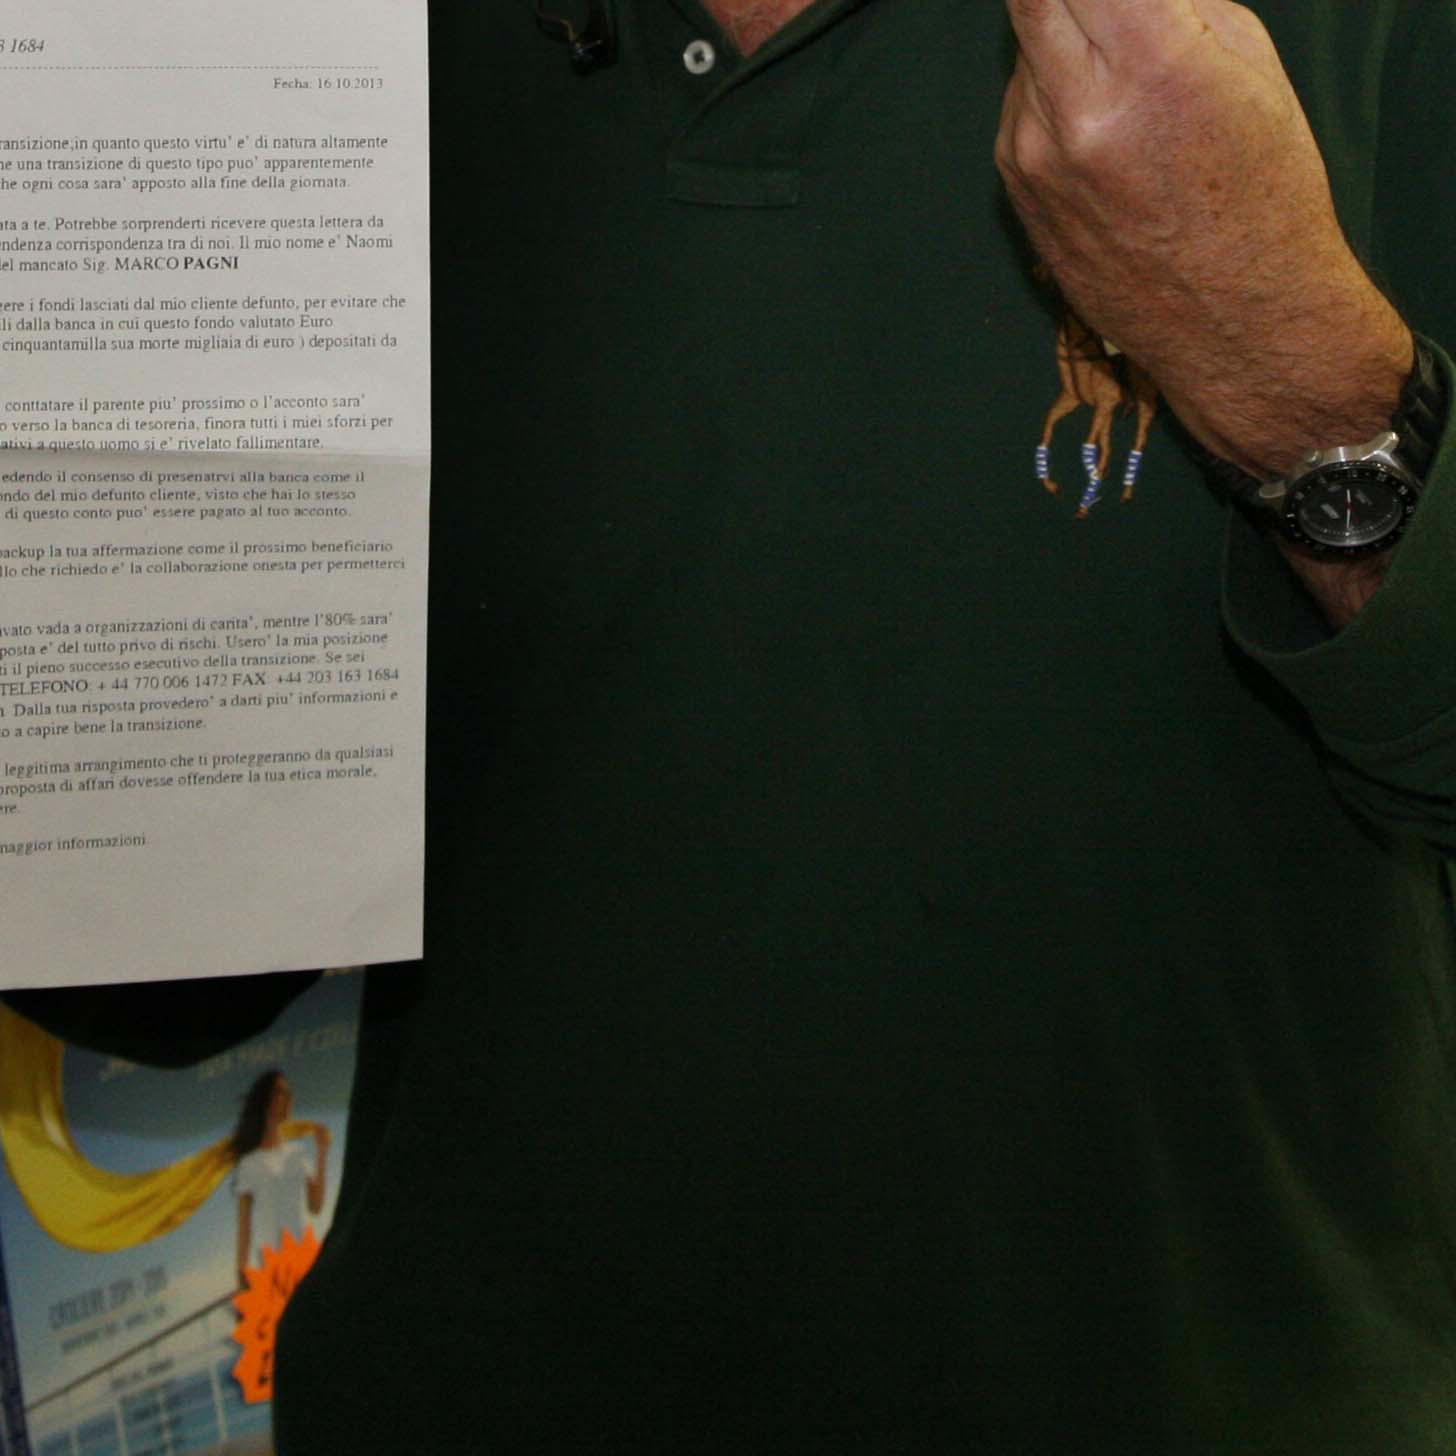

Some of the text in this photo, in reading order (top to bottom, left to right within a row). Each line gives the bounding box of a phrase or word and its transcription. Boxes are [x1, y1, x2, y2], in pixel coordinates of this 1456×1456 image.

[9, 37, 44, 54] 1684
[91, 136, 140, 154] quanto
[142, 136, 190, 153] questo
[254, 133, 268, 149] di
[272, 136, 316, 150] natura
[320, 133, 388, 149] altamente
[18, 259, 78, 272] mancato
[82, 255, 109, 274] Sig.
[114, 255, 180, 271] MARCO
[182, 254, 239, 270] PAGNI
[4, 399, 75, 413] conttatare
[78, 396, 88, 412] il
[92, 398, 145, 415] parente
[180, 395, 246, 414] prossimo
[248, 397, 259, 409] o
[262, 394, 328, 409] l'acconto
[111, 677, 128, 690] 44
[135, 675, 160, 690] 770
[162, 674, 189, 689] 006
[195, 672, 227, 688] 1472
[277, 671, 301, 684] +44
[307, 669, 331, 684] 203
[338, 668, 361, 683] 163
[368, 667, 399, 681] 1684
[13, 701, 52, 717] Dalla
[54, 703, 77, 714] tua
[81, 700, 135, 716] risposta
[219, 698, 227, 707] a
[230, 693, 262, 707] darti
[298, 688, 386, 705] informazioni
[389, 690, 398, 700] e
